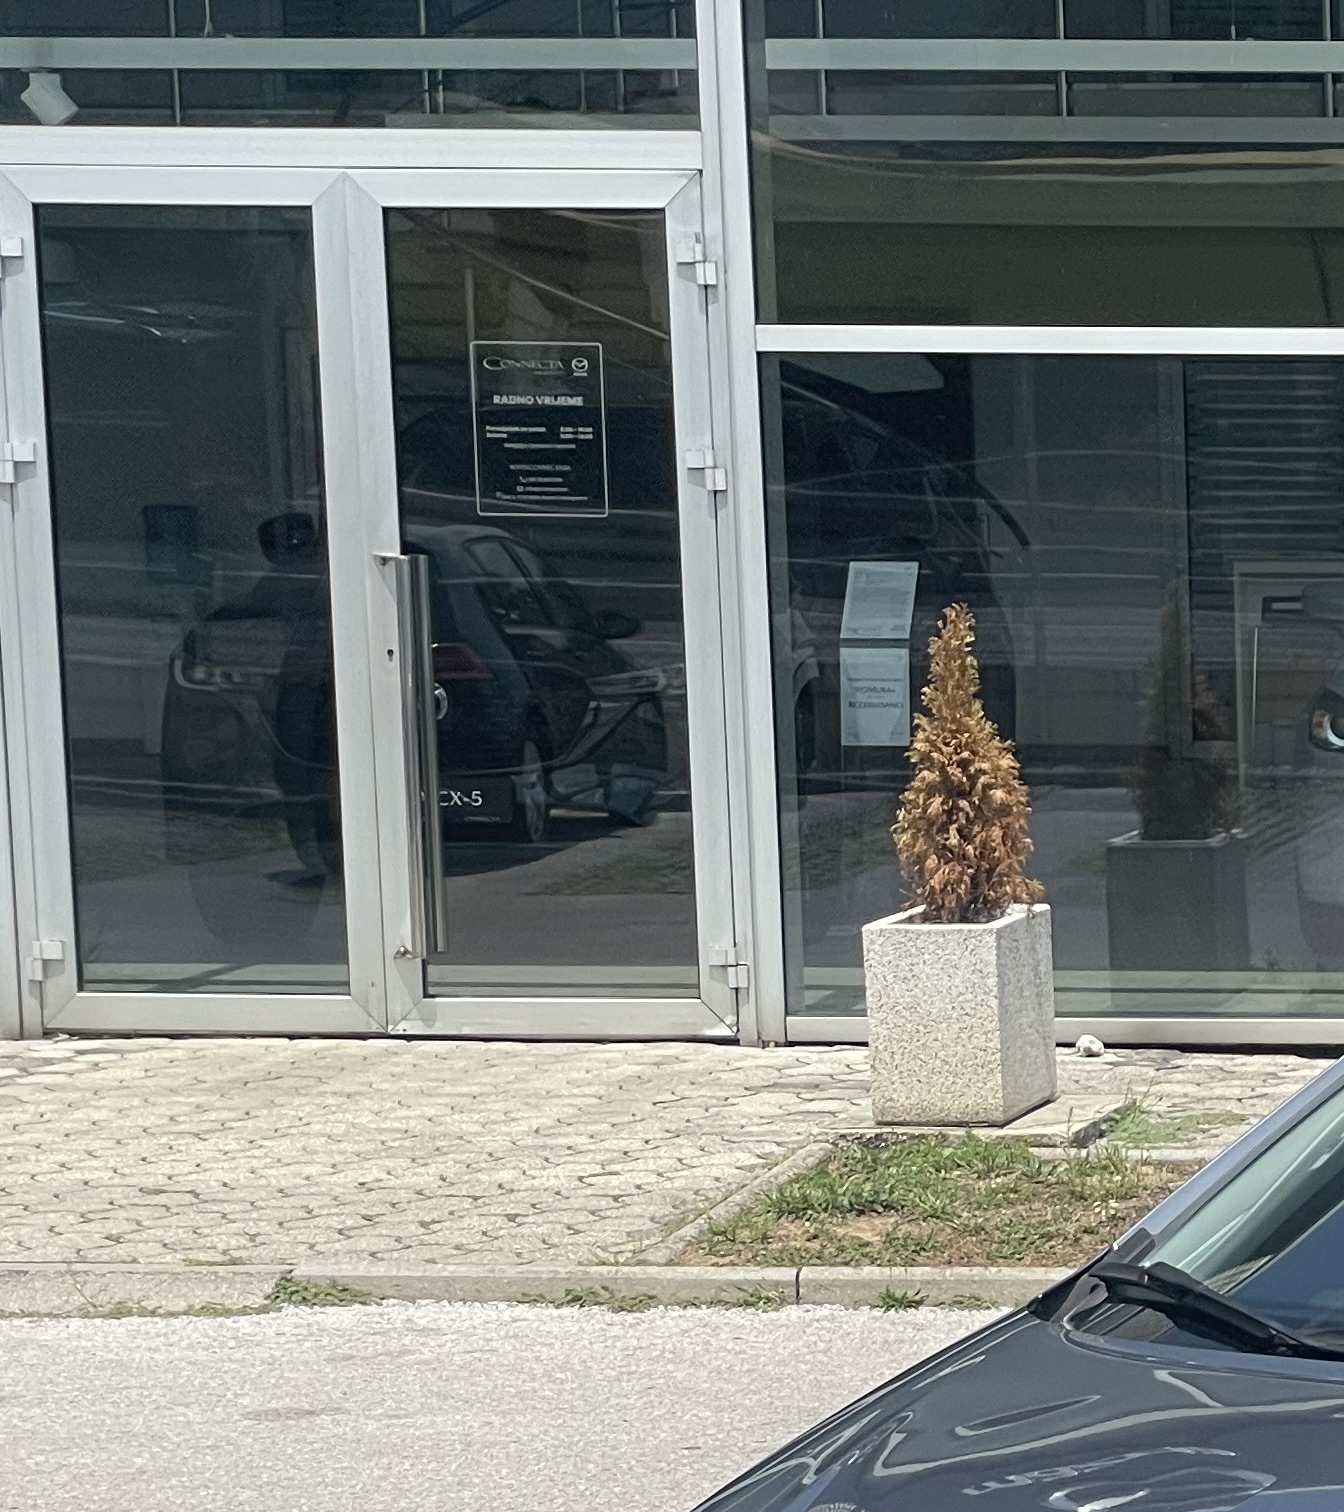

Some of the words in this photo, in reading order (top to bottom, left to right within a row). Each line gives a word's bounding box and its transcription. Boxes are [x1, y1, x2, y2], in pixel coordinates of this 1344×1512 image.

[482, 356, 565, 371] CONNECTA
[493, 395, 534, 405] RADNO
[536, 396, 584, 406] VRIJEME
